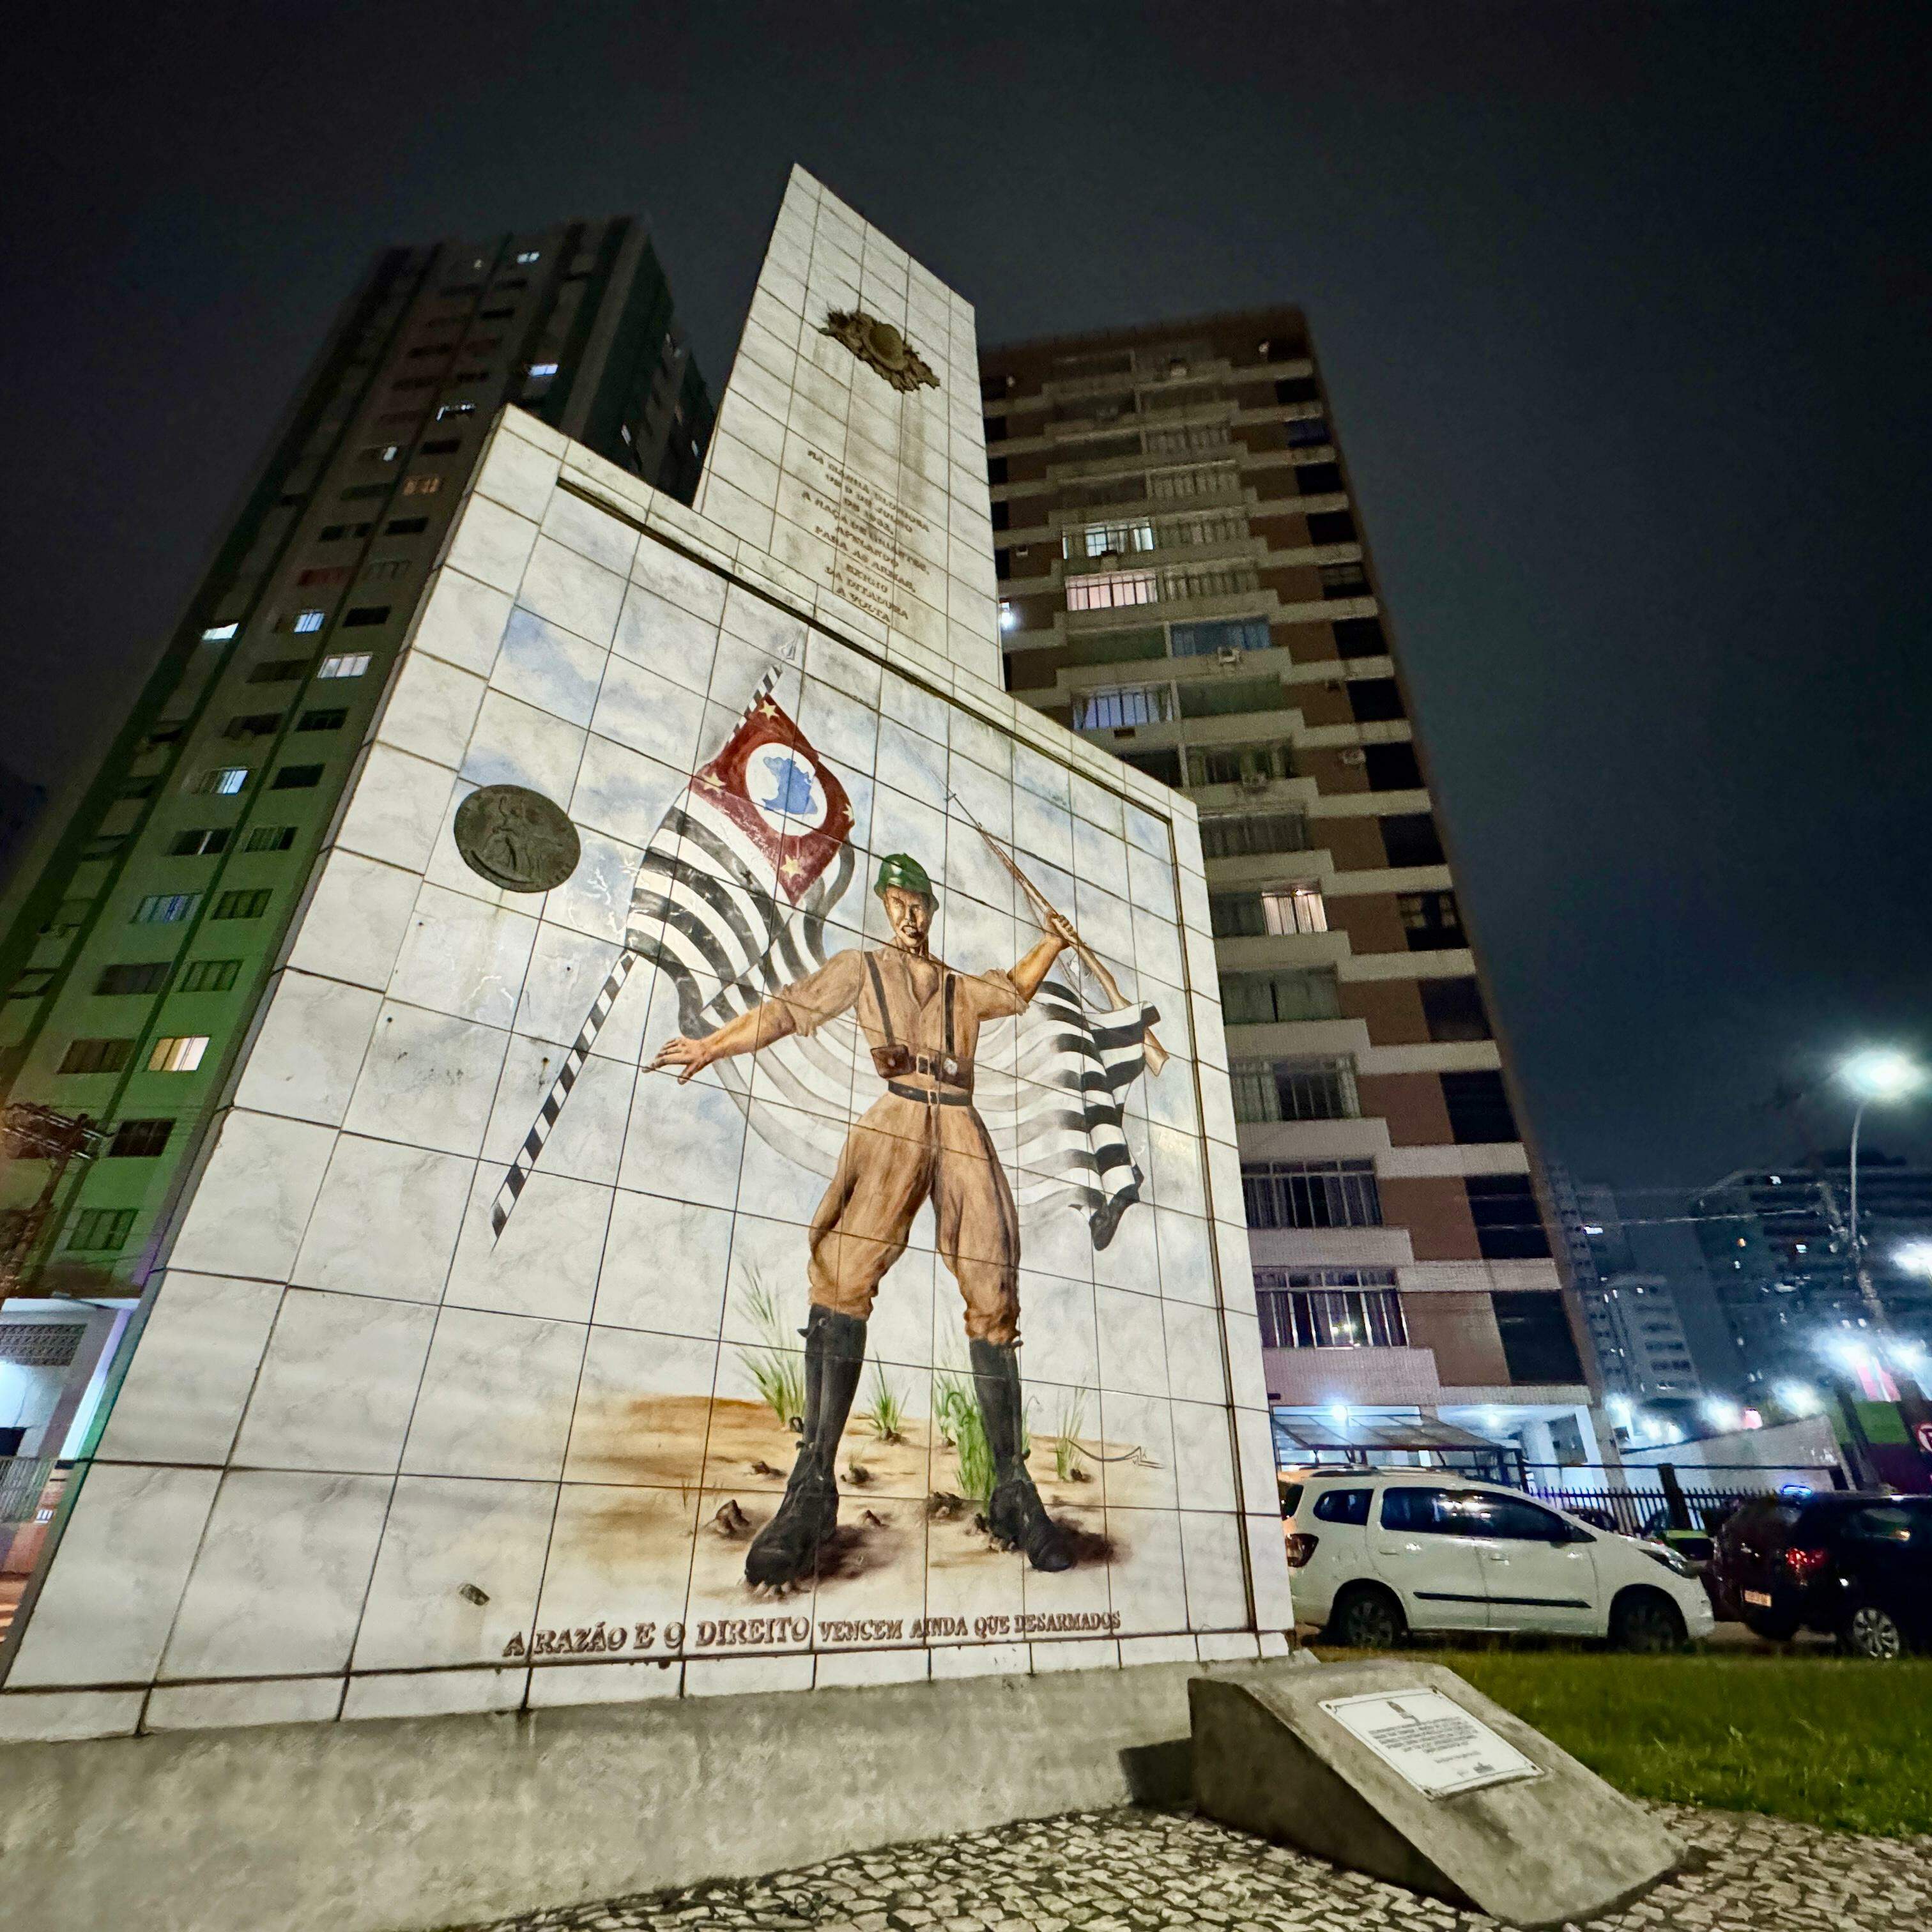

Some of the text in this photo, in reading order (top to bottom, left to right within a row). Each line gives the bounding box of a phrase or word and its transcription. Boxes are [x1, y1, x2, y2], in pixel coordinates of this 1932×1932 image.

[802, 491, 811, 501] A
[500, 1631, 525, 1657] A
[633, 1621, 656, 1649] E
[664, 1621, 686, 1648] O
[696, 1616, 810, 1646] DIREITO
[818, 1618, 903, 1642] VENCEM
[909, 1616, 969, 1638] AINDA
[974, 1614, 1009, 1639] QUE
[1014, 1610, 1121, 1634] DESARMADOS
